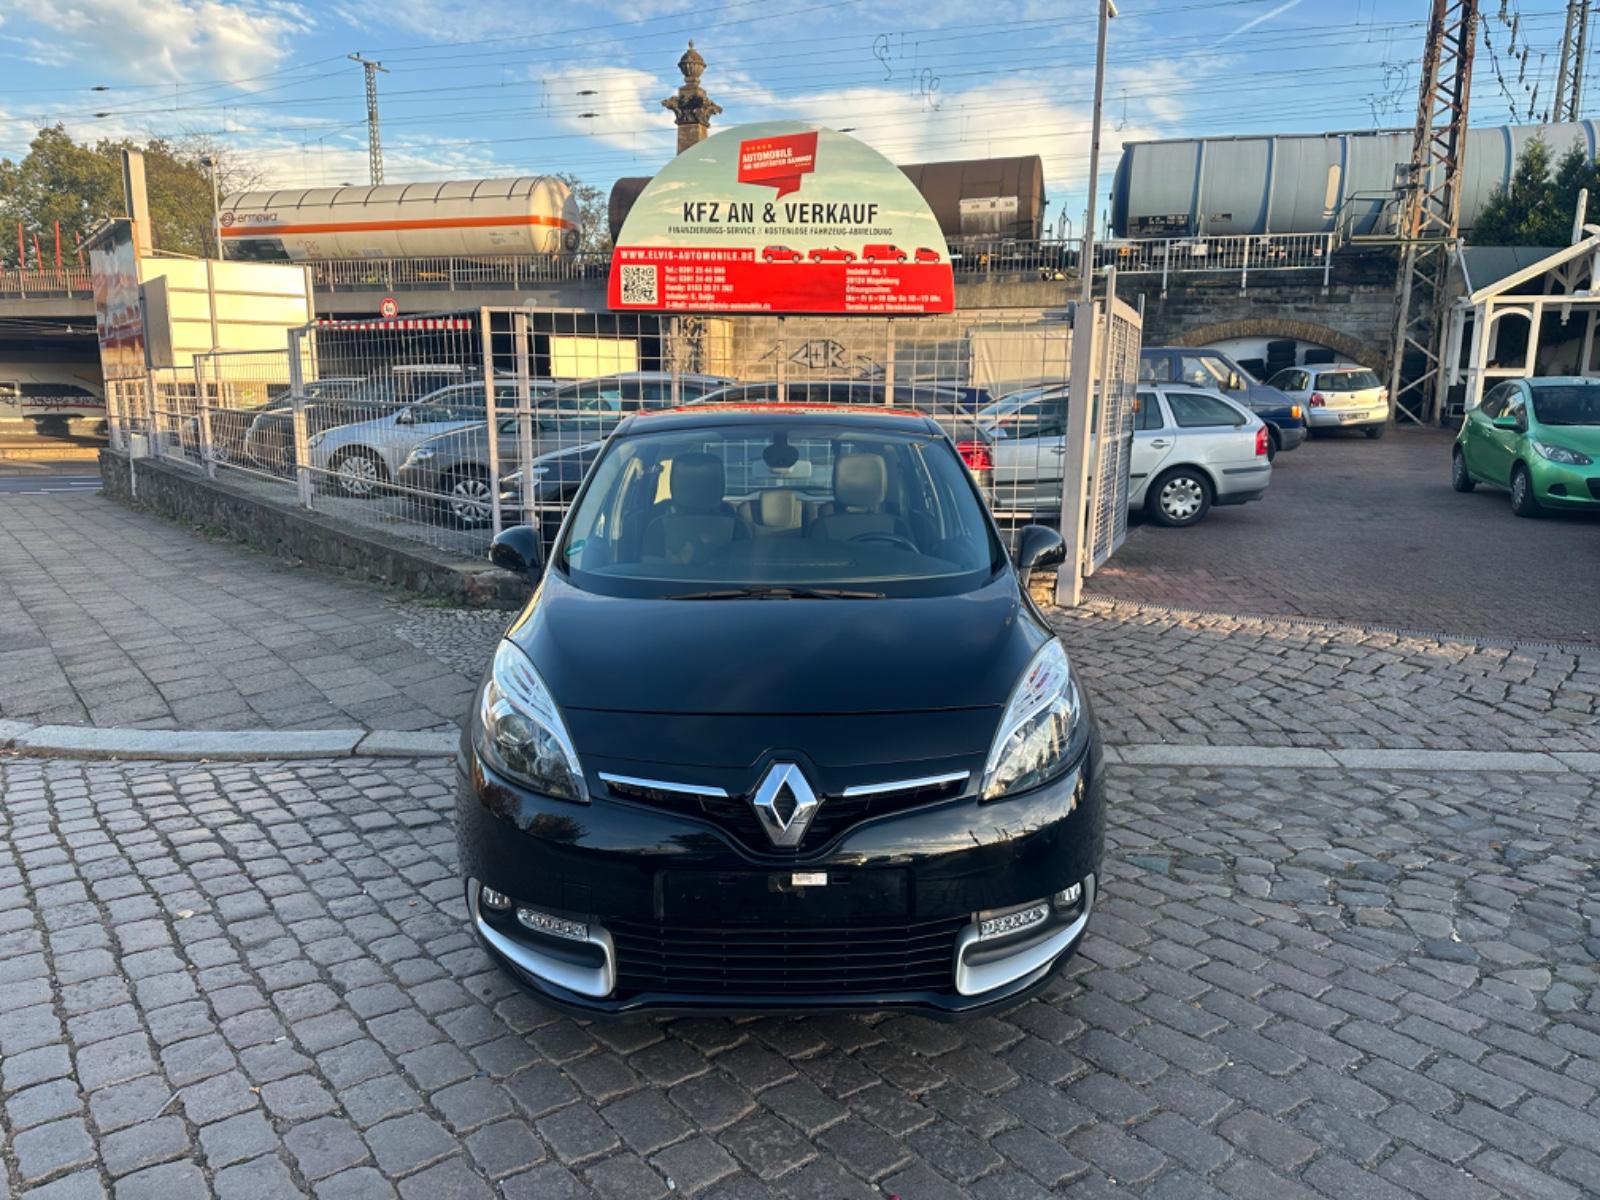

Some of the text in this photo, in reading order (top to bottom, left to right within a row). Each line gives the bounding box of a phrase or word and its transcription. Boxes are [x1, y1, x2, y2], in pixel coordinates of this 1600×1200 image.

[742, 147, 792, 163] AUTOMOBILE
[683, 202, 879, 224] KFZ AN & VERKAUF
[668, 226, 755, 235] FINANZIERUNGS-SERVICE
[764, 227, 808, 236] KOSTENLOSE
[810, 227, 893, 236] FAHRZEUG-ABMELDUNG
[621, 250, 753, 261] WWW.ELVIS-AUTOMOBILE.DE
